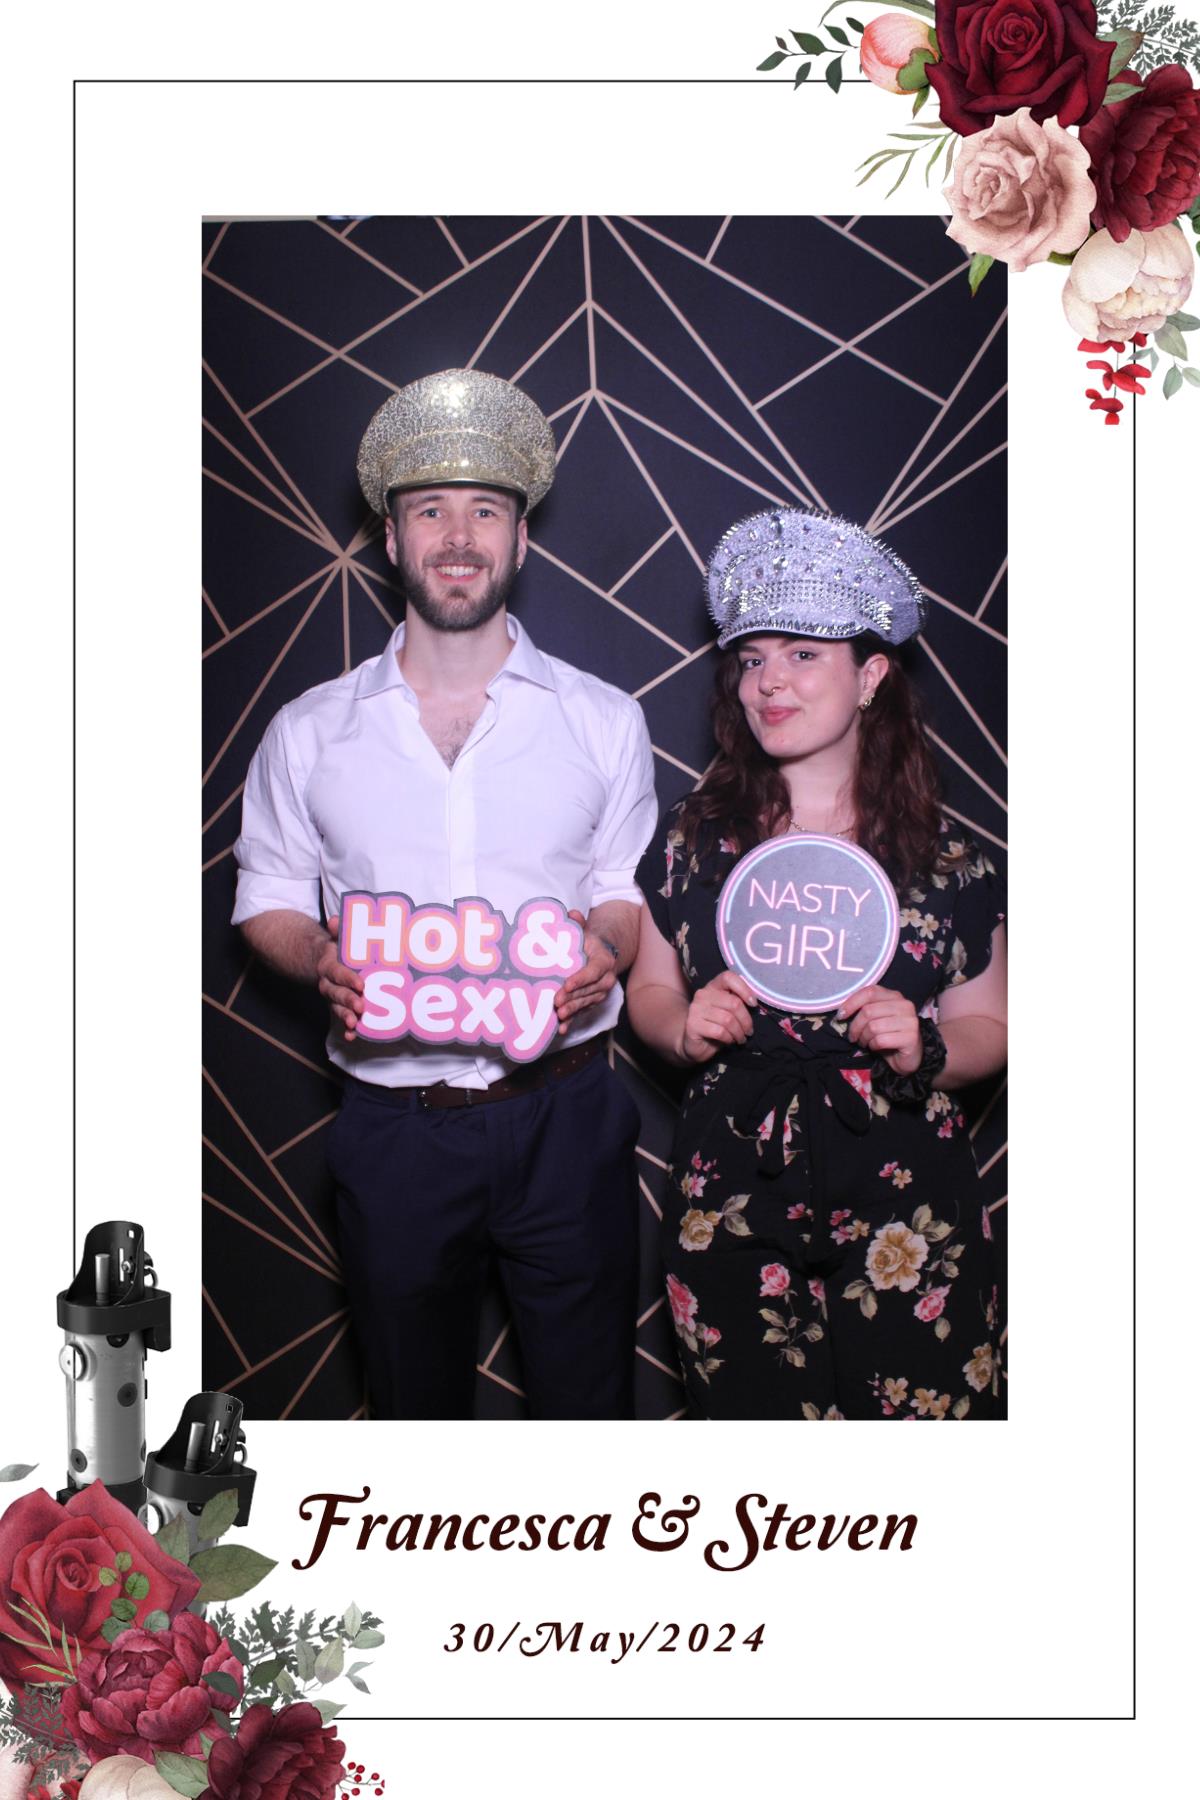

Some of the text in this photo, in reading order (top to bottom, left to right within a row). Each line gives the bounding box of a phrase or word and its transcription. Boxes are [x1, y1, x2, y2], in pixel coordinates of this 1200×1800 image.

[748, 877, 872, 918] NASTY
[350, 902, 574, 969] Hot &
[744, 920, 865, 973] GIRL
[361, 970, 556, 1051] Sexy
